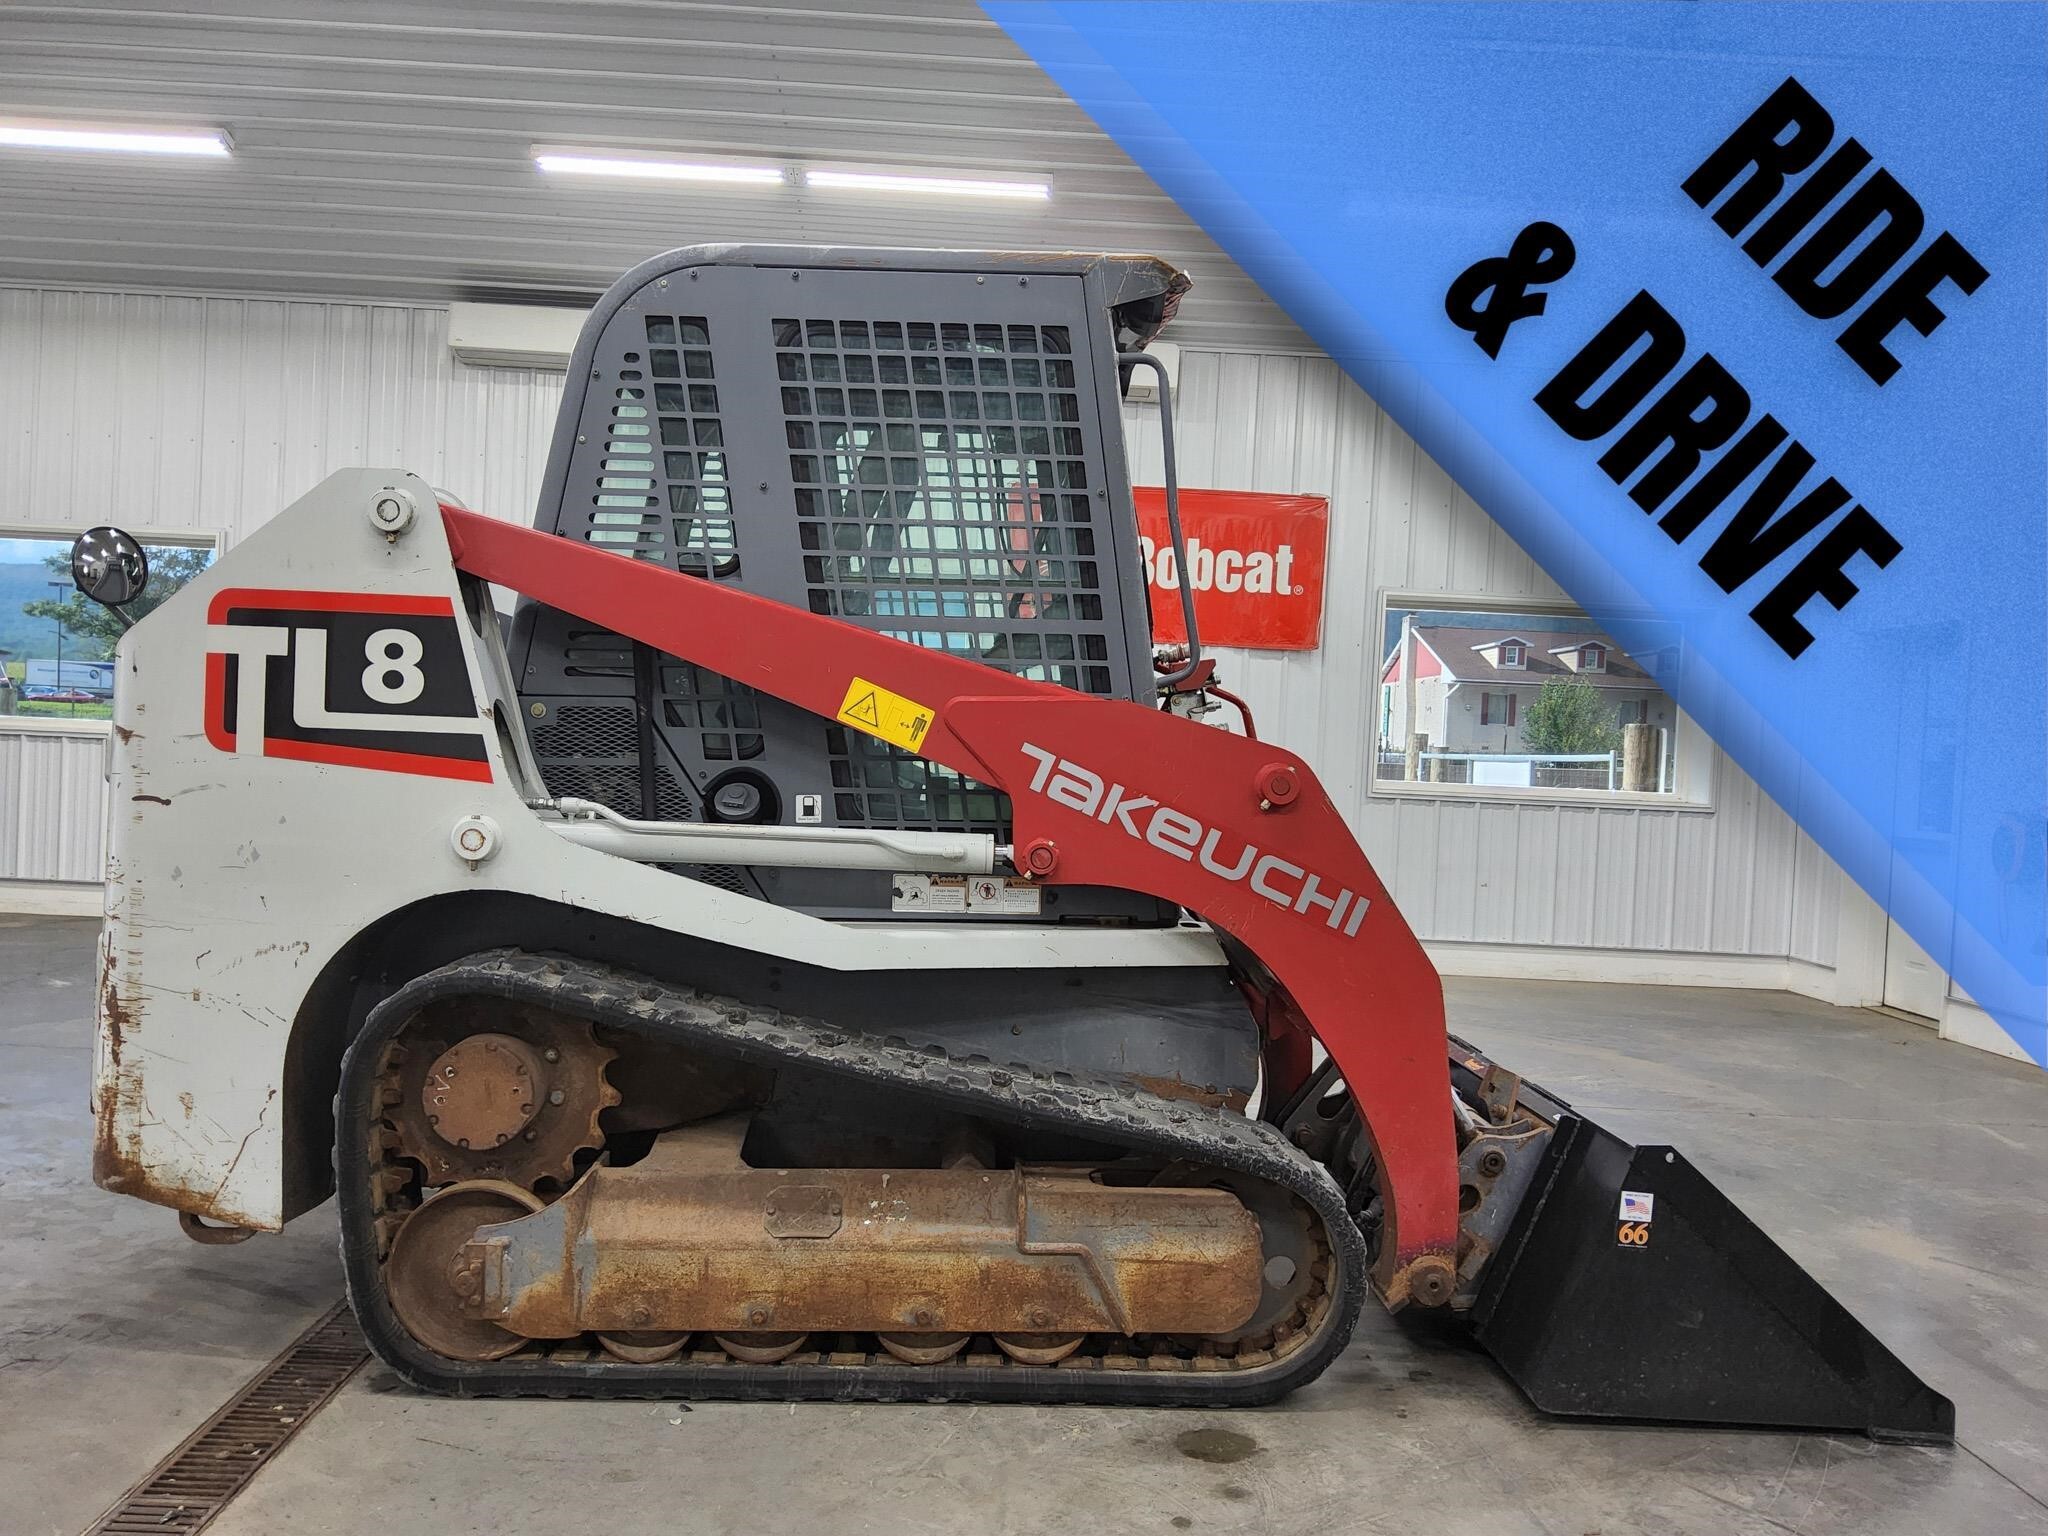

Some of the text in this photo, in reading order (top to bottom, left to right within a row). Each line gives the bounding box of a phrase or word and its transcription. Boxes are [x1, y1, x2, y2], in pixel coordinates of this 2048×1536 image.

[1139, 536, 1294, 595] Bobcat
[206, 623, 486, 757] TL8
[1618, 1221, 1649, 1245] 66
